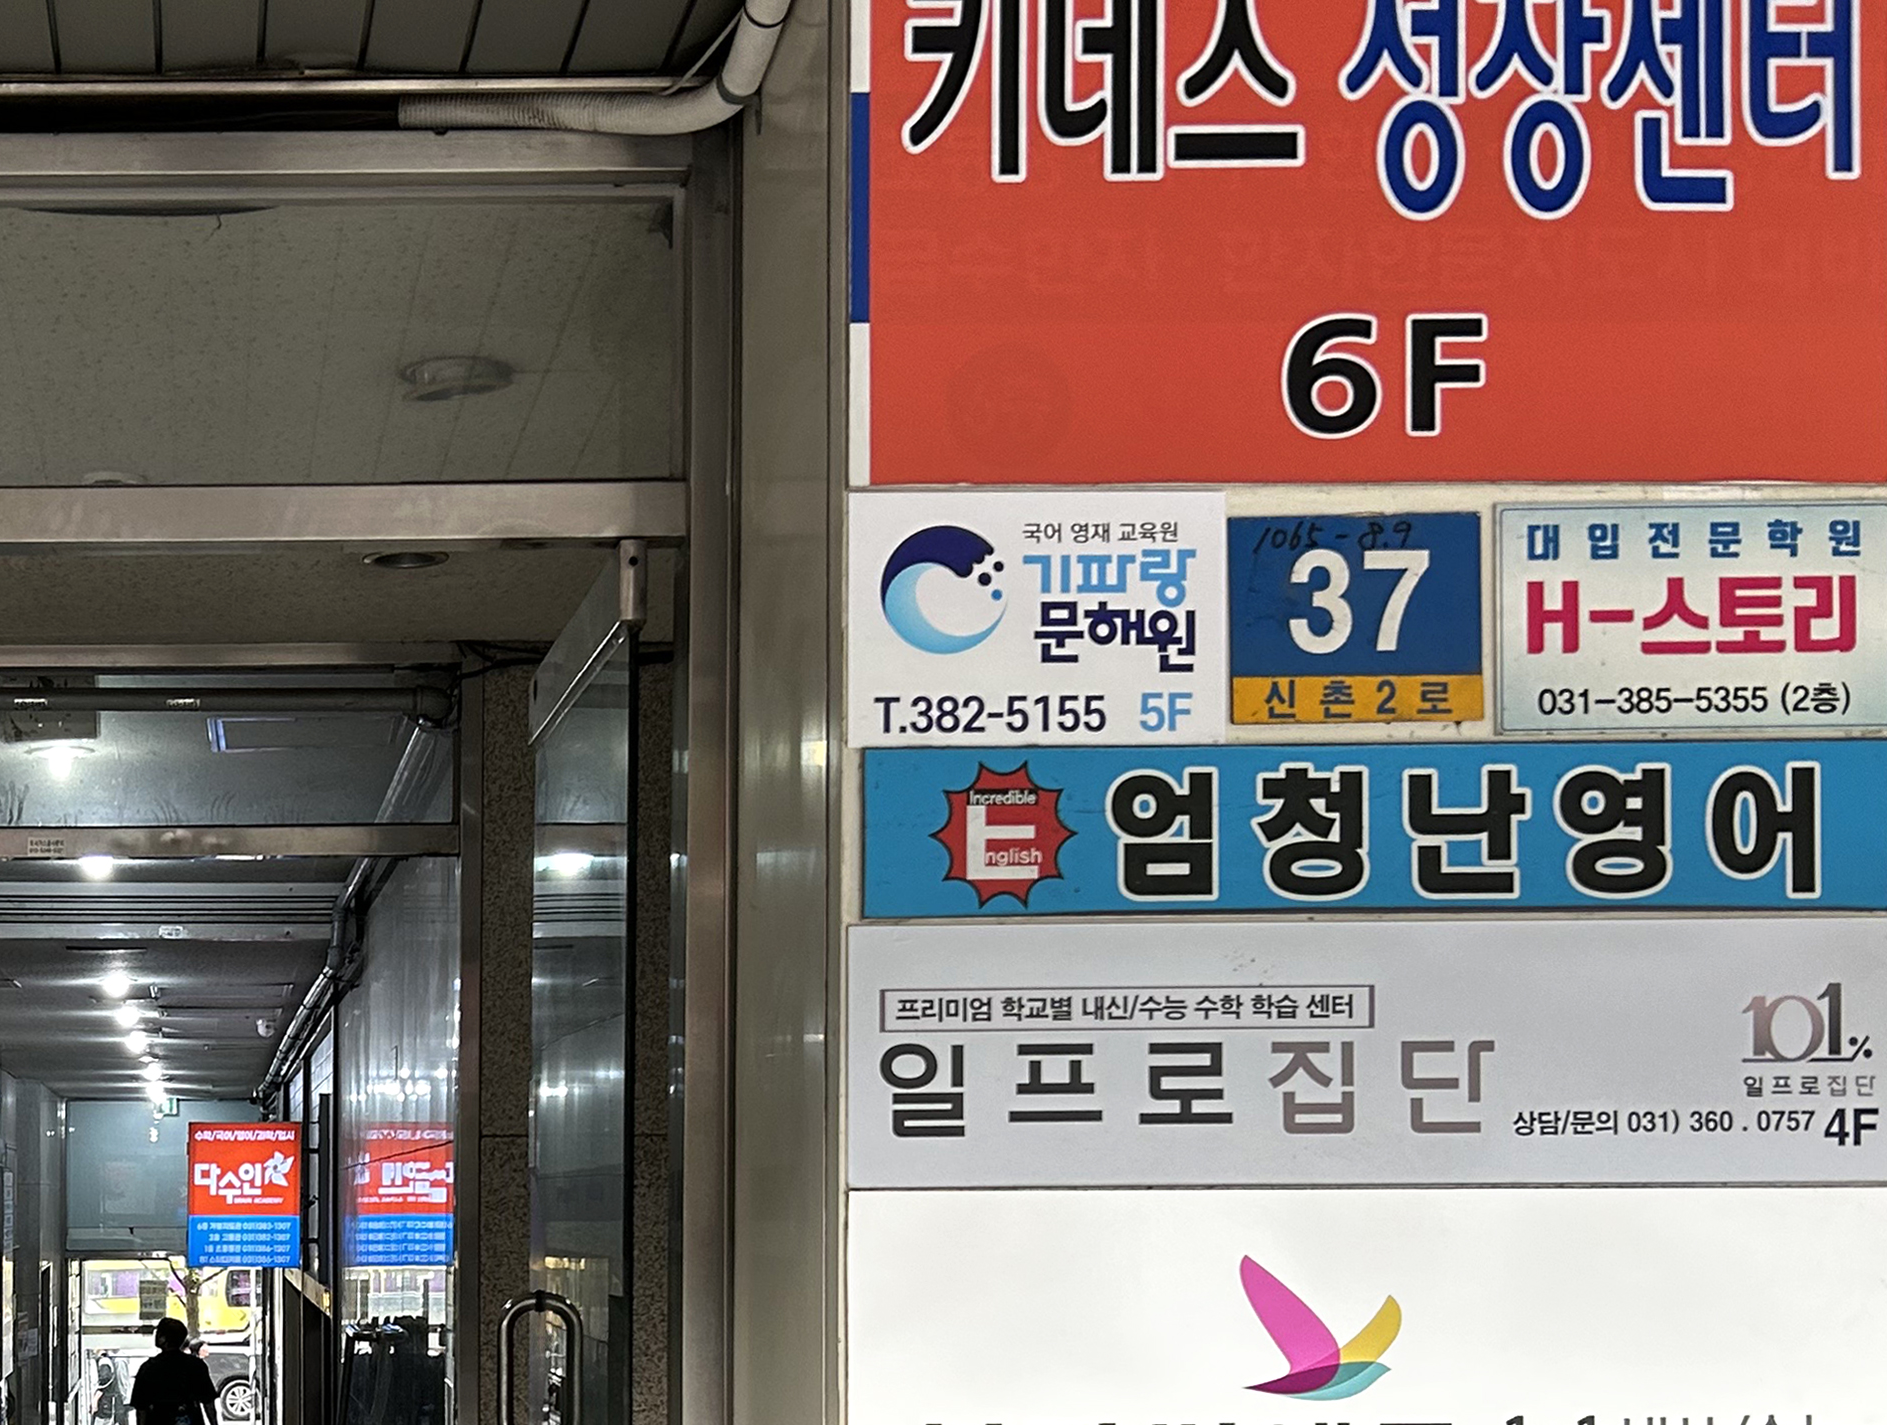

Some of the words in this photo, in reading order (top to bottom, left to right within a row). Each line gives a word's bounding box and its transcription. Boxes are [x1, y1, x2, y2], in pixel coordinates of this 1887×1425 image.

[1281, 314, 1487, 438] 6F
[1023, 522, 1063, 543] 국어
[1070, 522, 1111, 543] 영재
[1118, 522, 1179, 543] 교육원
[1022, 549, 1196, 608] 기파랑
[1288, 548, 1430, 654] 37
[1527, 575, 1857, 655] H-스토리
[1034, 601, 1196, 673] 문해원
[874, 695, 1107, 734] T.382-5155
[1139, 692, 1193, 732] 5F
[1538, 685, 1768, 716] 031-385-5355
[1781, 681, 1851, 716] (2층)
[969, 790, 1037, 805] Incredible
[894, 997, 993, 1022] 프리미엄
[1001, 996, 1073, 1022] 학교별
[1080, 994, 1187, 1022] 내신/수능
[1194, 995, 1243, 1021] 수학
[1251, 993, 1300, 1020] 학습
[1306, 993, 1355, 1019] 센터
[879, 1040, 1496, 1138] 일프로집단
[1742, 1075, 1876, 1097] 일프로집단
[1513, 1109, 1619, 1135] 상담/문의
[1627, 1110, 1680, 1134] 031)
[1689, 1110, 1733, 1132] 360
[1756, 1110, 1816, 1132] 0757
[1824, 1108, 1879, 1146] 4F
[194, 1162, 262, 1204] 다수인
